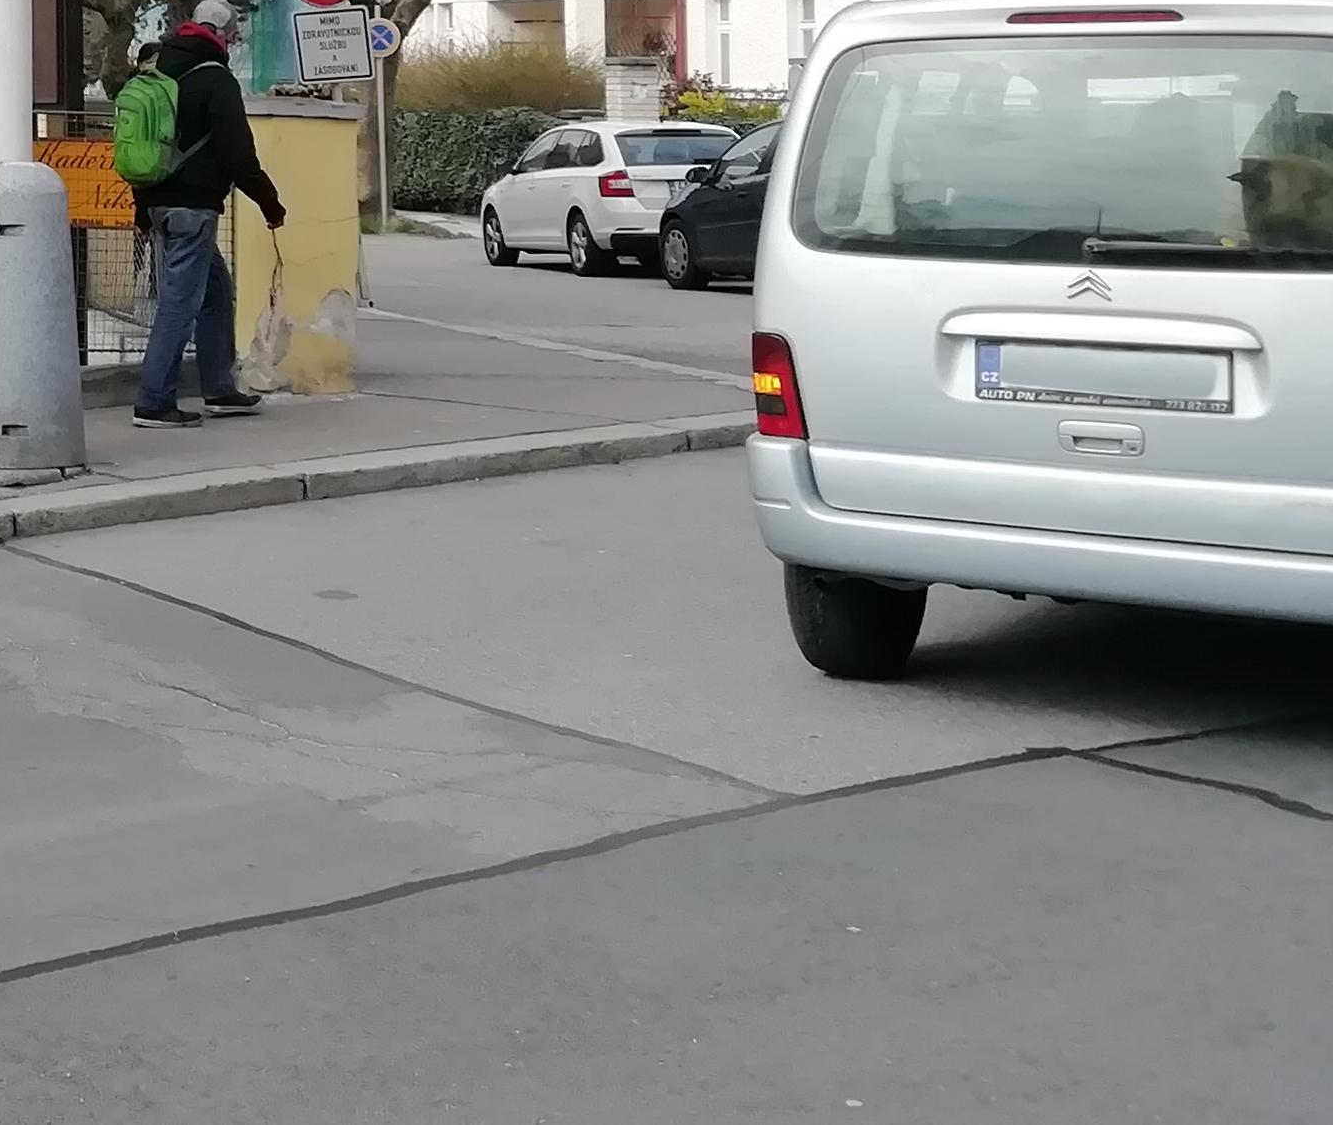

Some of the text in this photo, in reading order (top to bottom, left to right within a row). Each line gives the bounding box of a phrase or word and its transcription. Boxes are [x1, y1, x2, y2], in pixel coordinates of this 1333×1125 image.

[319, 16, 340, 25] MIMO
[302, 27, 362, 40] ZDRAVOTNICKOU
[319, 40, 347, 50] SLUŽBU
[332, 54, 338, 62] A
[981, 372, 999, 383] CZ
[979, 389, 1014, 400] AUTO
[1015, 391, 1036, 402] PN
